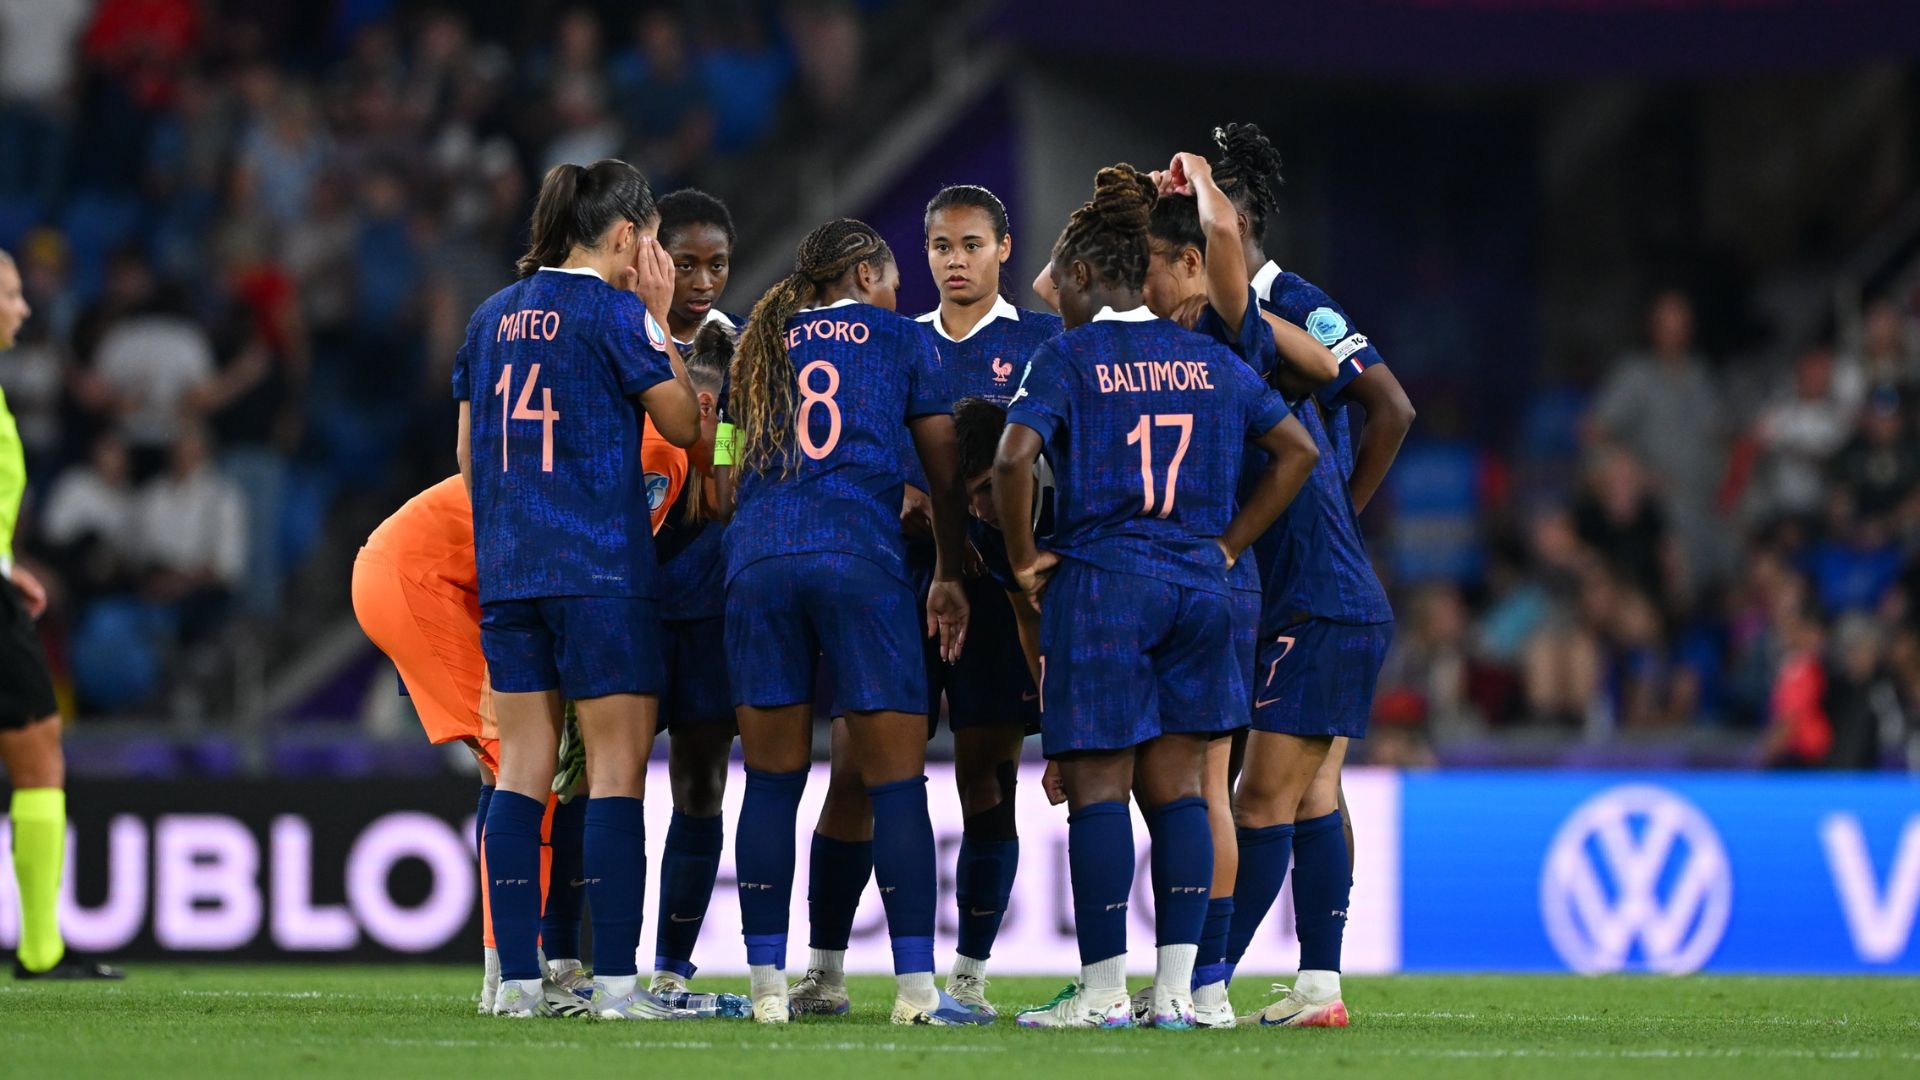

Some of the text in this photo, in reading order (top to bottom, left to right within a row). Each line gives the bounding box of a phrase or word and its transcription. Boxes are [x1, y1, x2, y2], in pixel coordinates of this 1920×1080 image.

[497, 309, 560, 342] MATEO
[495, 363, 560, 473] 14
[797, 359, 842, 460] 8
[1096, 360, 1214, 394] BALTIMORE
[1126, 413, 1194, 519] 17
[1265, 635, 1296, 687] 7
[0, 811, 480, 953] UBLO
